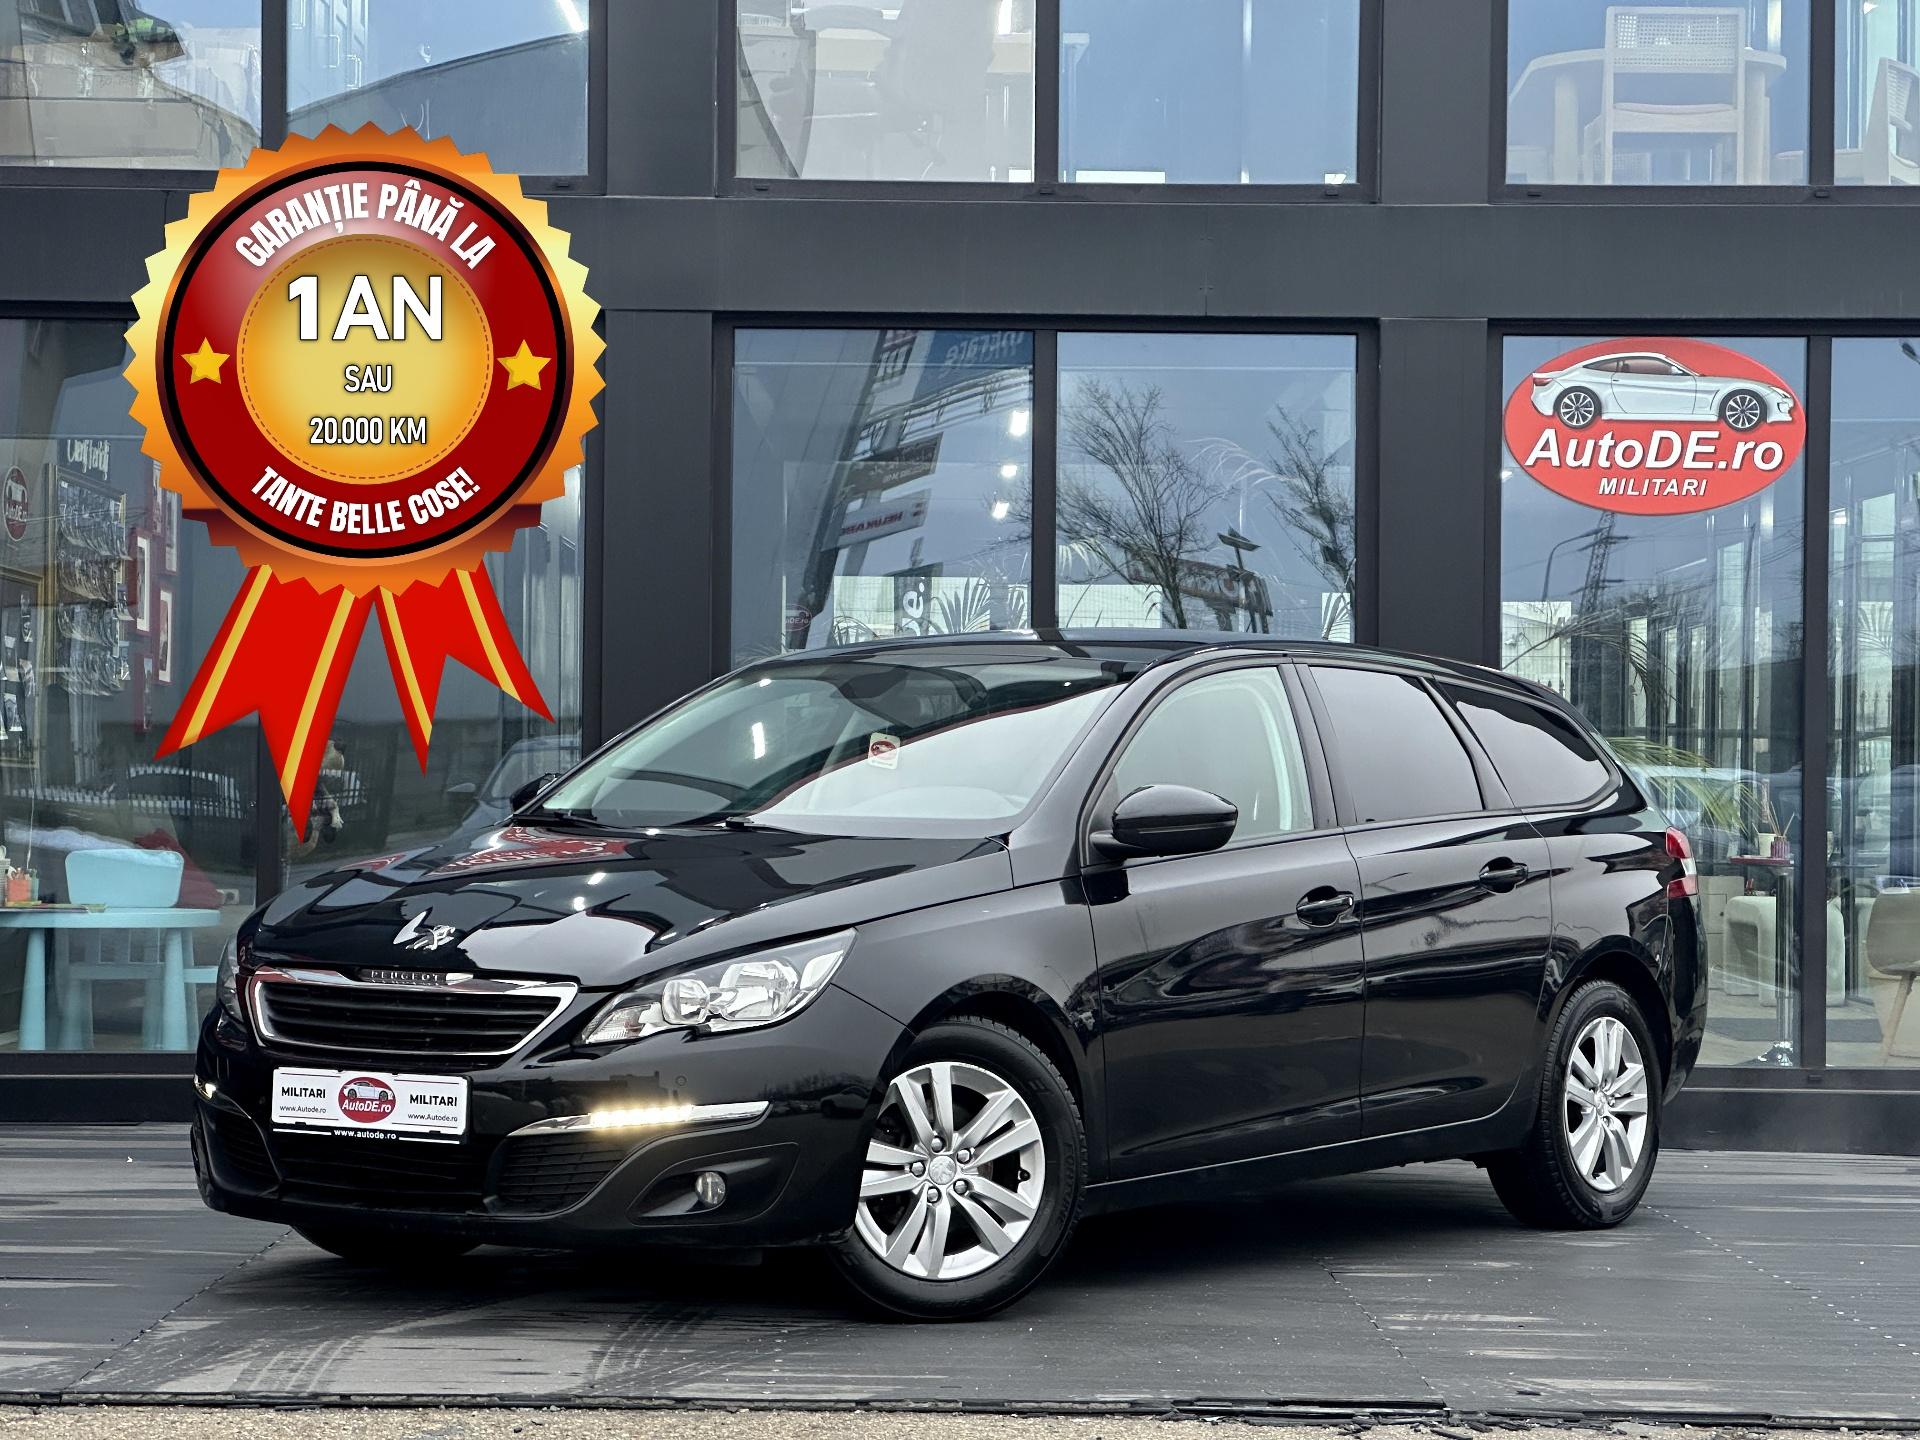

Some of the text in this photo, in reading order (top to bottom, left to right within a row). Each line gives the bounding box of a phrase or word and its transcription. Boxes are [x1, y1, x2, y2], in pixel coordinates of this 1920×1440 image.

[1524, 428, 1784, 471] AutoDE.ro
[1598, 477, 1707, 497] MILITARI
[371, 969, 439, 981] PEUGEOT
[281, 1086, 326, 1099] MILITARI
[341, 1099, 392, 1114] AutoDE.ro
[409, 1093, 458, 1108] MILITARI
[279, 1104, 327, 1114] www.Autode.ro
[407, 1112, 458, 1123] www.Autode.ro
[333, 1128, 397, 1141] www.autode.ro
